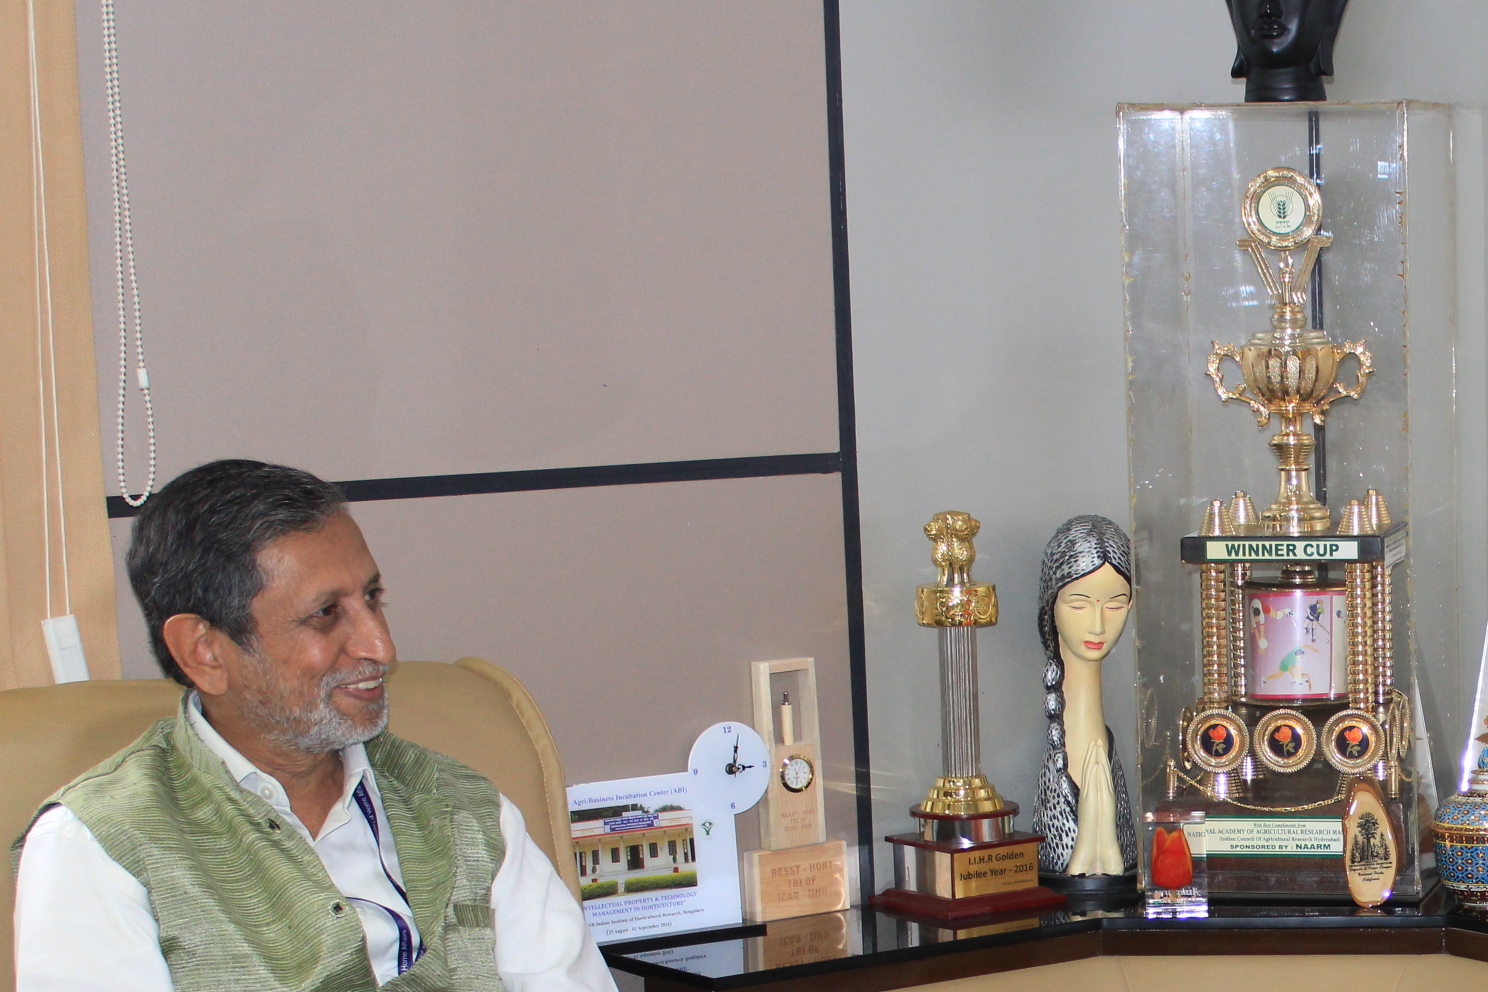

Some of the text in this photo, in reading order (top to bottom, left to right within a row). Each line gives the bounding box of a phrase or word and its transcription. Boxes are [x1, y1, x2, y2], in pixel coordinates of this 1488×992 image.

[1225, 543, 1340, 557] WINNER CUP
[573, 786, 688, 806] Agri-Business Incubation Center (ABI)
[968, 851, 1024, 865] I.I.H.R Golden
[771, 865, 802, 877] BESST
[809, 861, 834, 872] HORT
[960, 870, 987, 881] Jubilee
[990, 868, 1007, 876] Year
[1014, 863, 1033, 873] 2016
[805, 876, 817, 886] OF
[583, 901, 623, 911] NTELLECTUAL
[624, 897, 654, 906] PROPERTY
[660, 891, 698, 901] TECHNOLOGY
[777, 891, 799, 902] ICAR
[592, 907, 632, 917] MANAGEMENT
[611, 917, 628, 925] Institute
[634, 913, 661, 921] Horticultural
[638, 923, 660, 932] September
